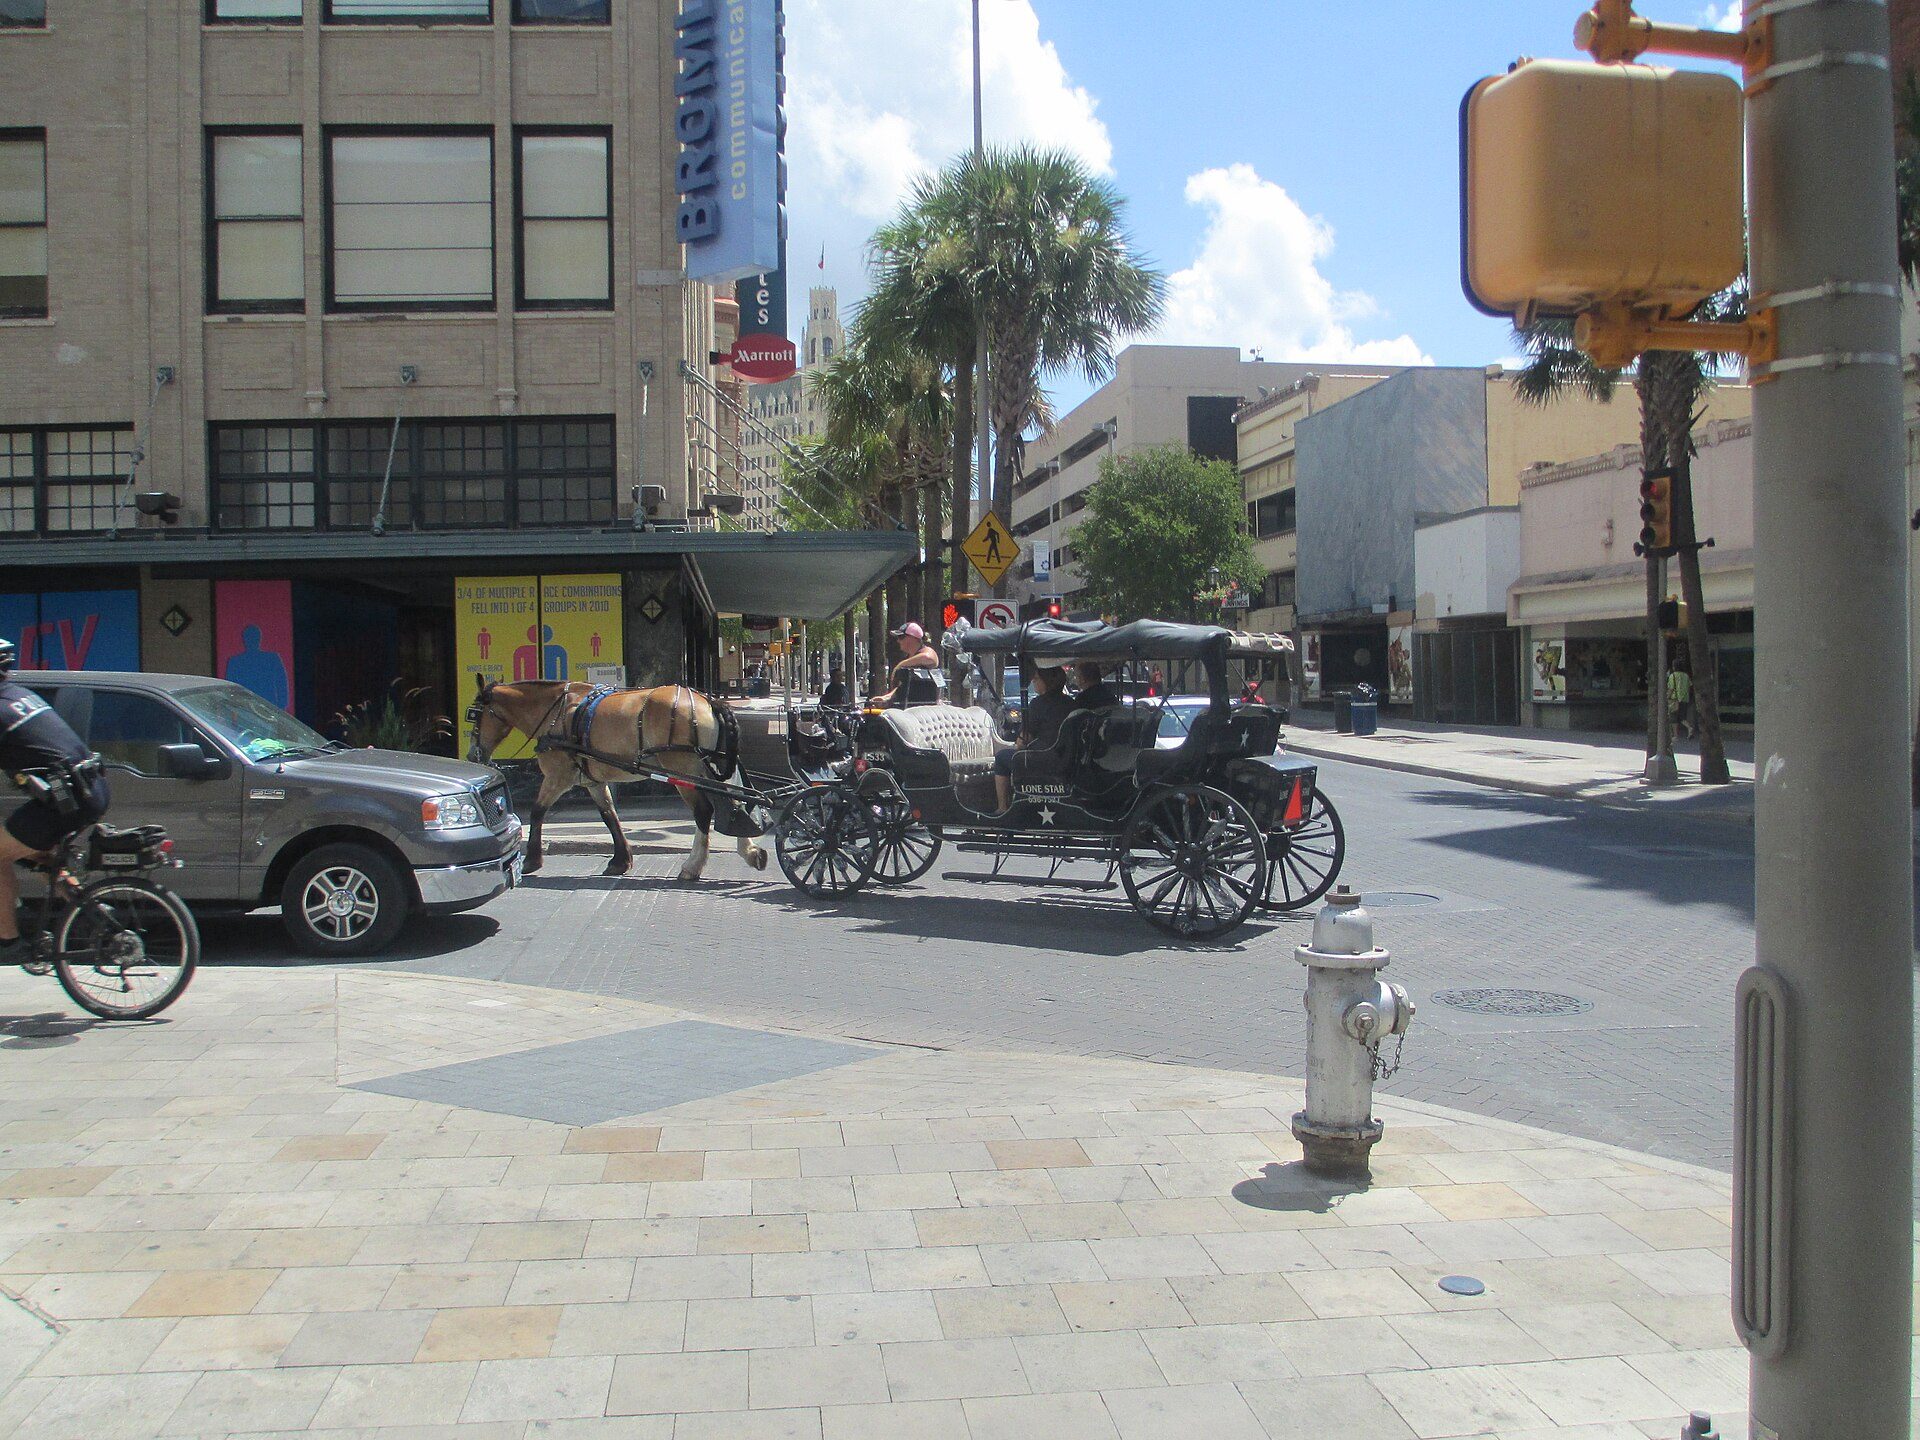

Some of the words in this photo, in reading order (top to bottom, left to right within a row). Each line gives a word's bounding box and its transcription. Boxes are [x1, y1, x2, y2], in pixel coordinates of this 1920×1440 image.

[734, 349, 793, 363] Marriott
[457, 588, 472, 600] 3/4
[476, 588, 486, 599] OF
[488, 587, 527, 599] MULTIPLE
[562, 585, 622, 598] COMBINATIONS
[471, 603, 489, 614] FELL
[490, 603, 508, 614] INTO
[517, 602, 527, 613] OF
[544, 601, 577, 613] GROUPS
[579, 601, 587, 612] IN
[589, 601, 610, 612] 2010
[1021, 785, 1043, 793] LONE
[1045, 785, 1065, 793] STAR
